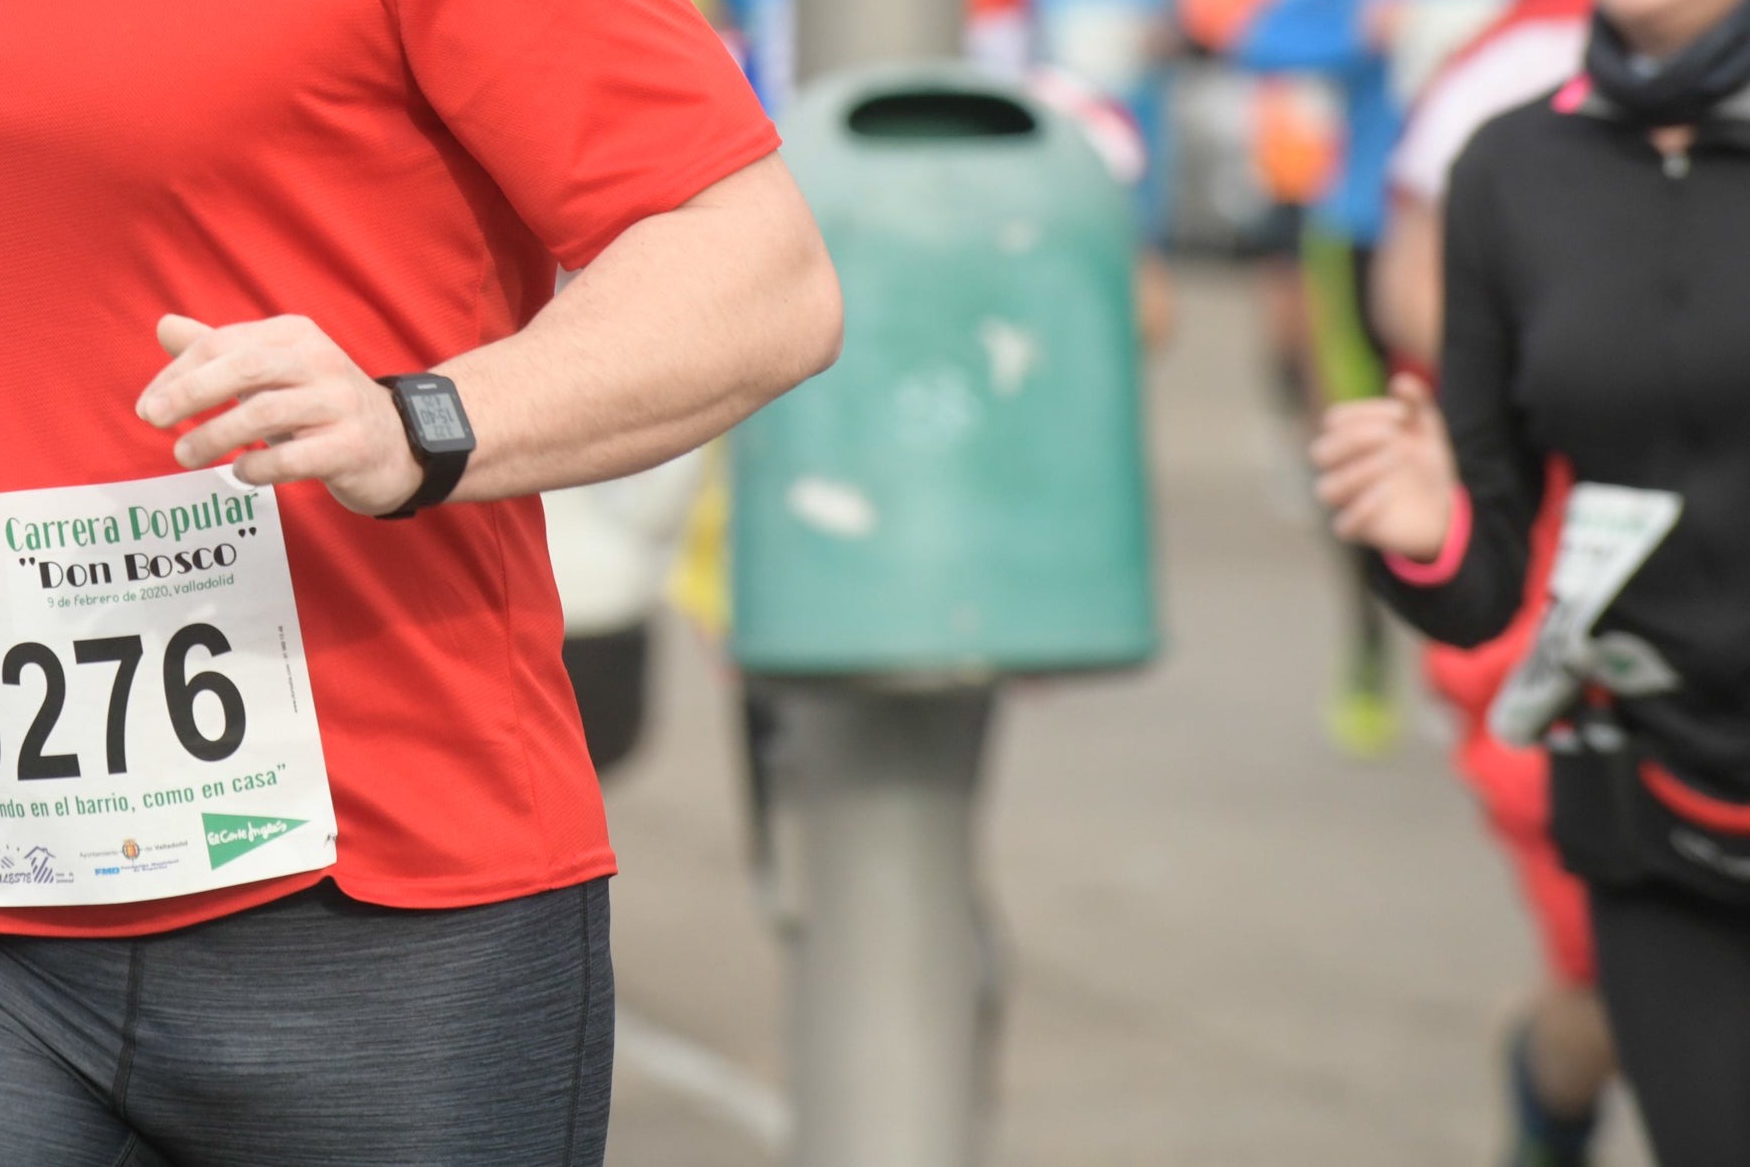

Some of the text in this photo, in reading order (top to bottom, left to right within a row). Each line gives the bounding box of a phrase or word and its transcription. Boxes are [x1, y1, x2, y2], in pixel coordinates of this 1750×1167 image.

[5, 492, 258, 552] Carrera Popular
[47, 597, 54, 608] 9
[58, 597, 71, 608] de
[74, 594, 119, 607] febrero
[123, 591, 137, 602] de
[140, 585, 172, 600] 2020,
[31, 801, 49, 817] en
[55, 797, 70, 817] el
[75, 792, 136, 815] barrio,
[143, 787, 194, 809] como
[202, 781, 225, 799] en
[232, 763, 286, 793] casa"
